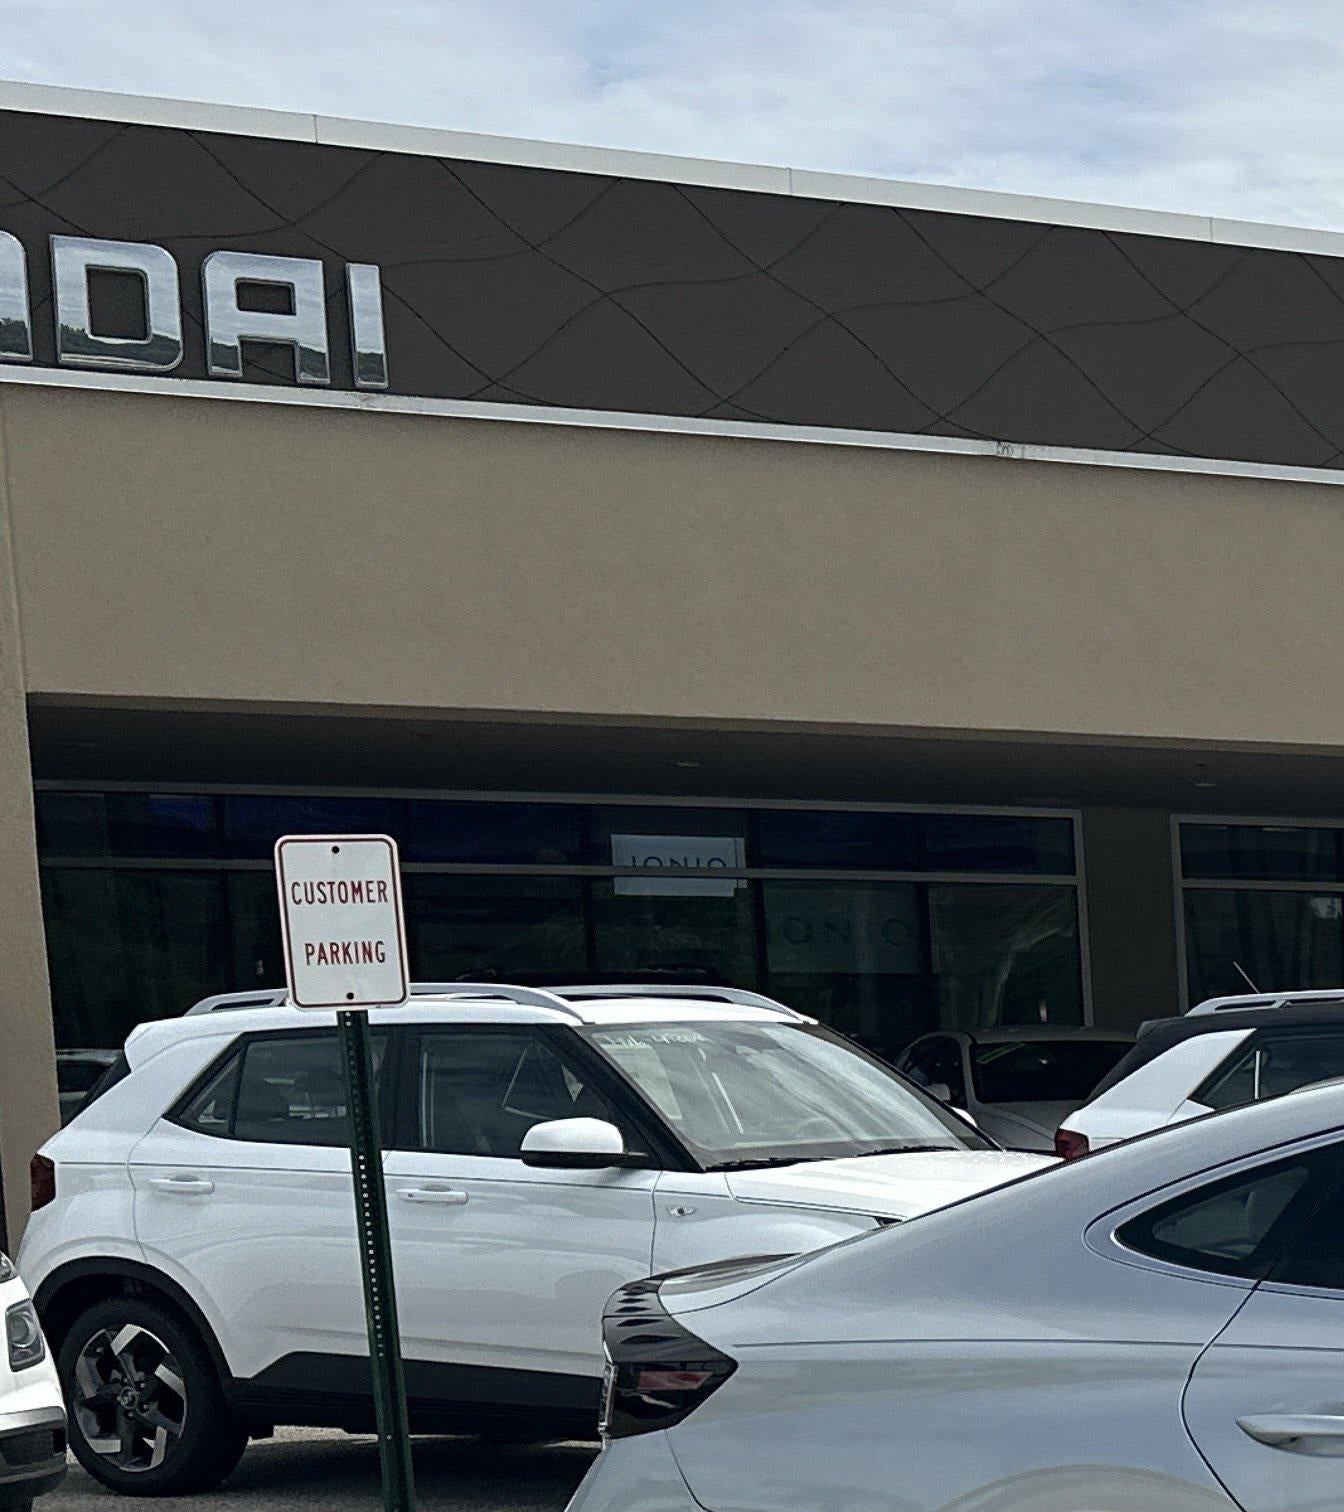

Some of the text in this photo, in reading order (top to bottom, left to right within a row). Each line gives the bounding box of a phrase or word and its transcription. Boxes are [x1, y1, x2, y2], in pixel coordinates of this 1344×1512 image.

[0, 230, 389, 389] DAI
[291, 880, 389, 905] CUSTOMER
[305, 941, 386, 965] PARKING
